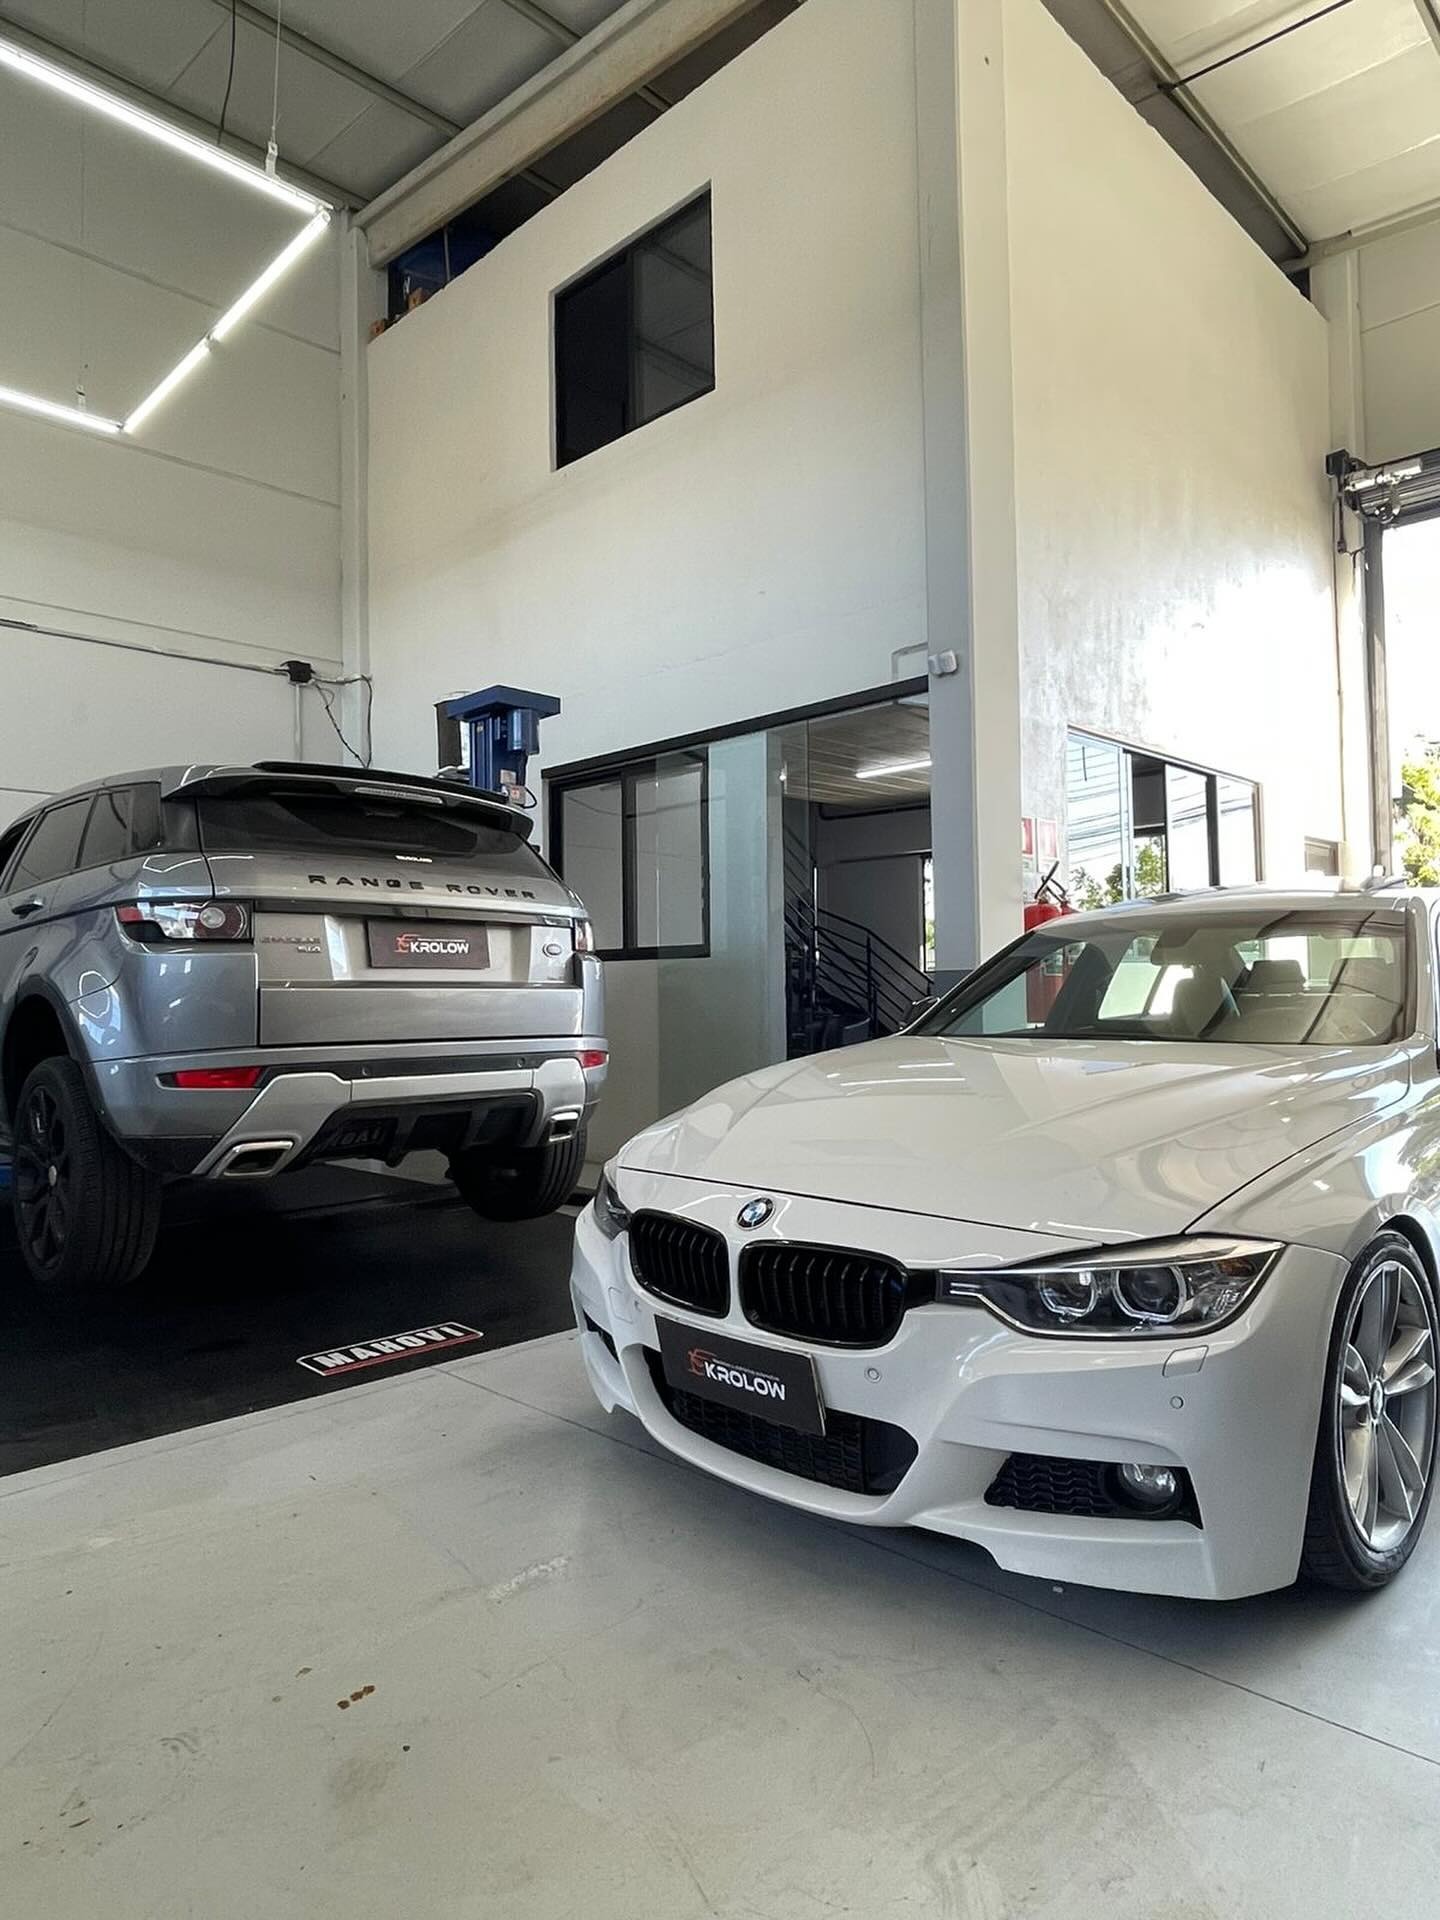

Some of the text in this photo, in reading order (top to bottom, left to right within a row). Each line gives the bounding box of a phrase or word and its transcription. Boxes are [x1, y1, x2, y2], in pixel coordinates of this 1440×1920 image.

[308, 874, 537, 900] RANGE ROVER
[410, 941, 469, 954] KROLOW
[312, 1325, 465, 1369] MAHOVI
[704, 1361, 785, 1401] KROLOW
